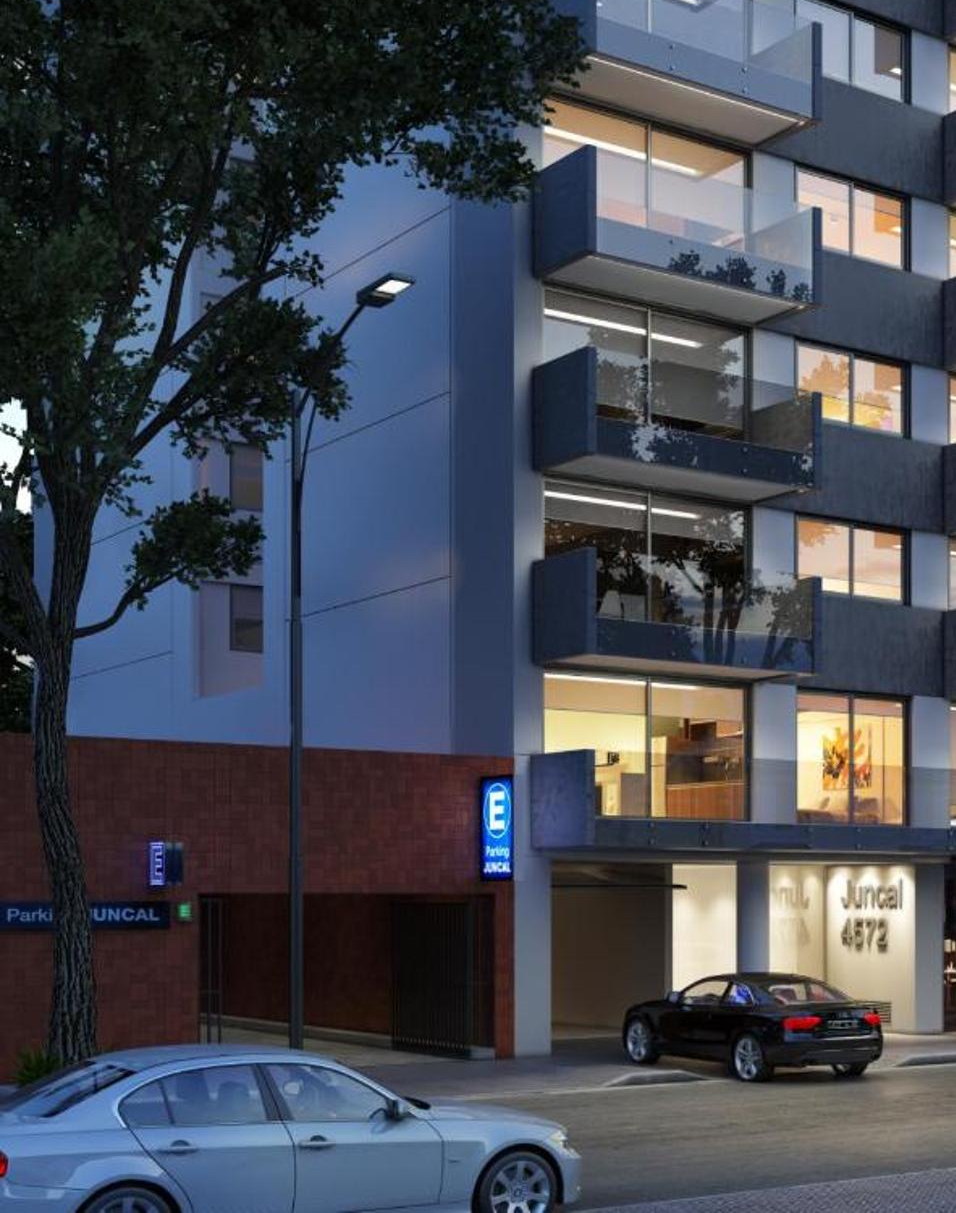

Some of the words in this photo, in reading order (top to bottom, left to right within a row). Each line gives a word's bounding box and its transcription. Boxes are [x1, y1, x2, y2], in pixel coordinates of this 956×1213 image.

[489, 791, 505, 830] E
[485, 845, 510, 860] Parking
[483, 861, 511, 873] JUNCAL
[841, 879, 903, 909] Juncal
[6, 908, 53, 923] Parki
[841, 917, 889, 953] 4572
